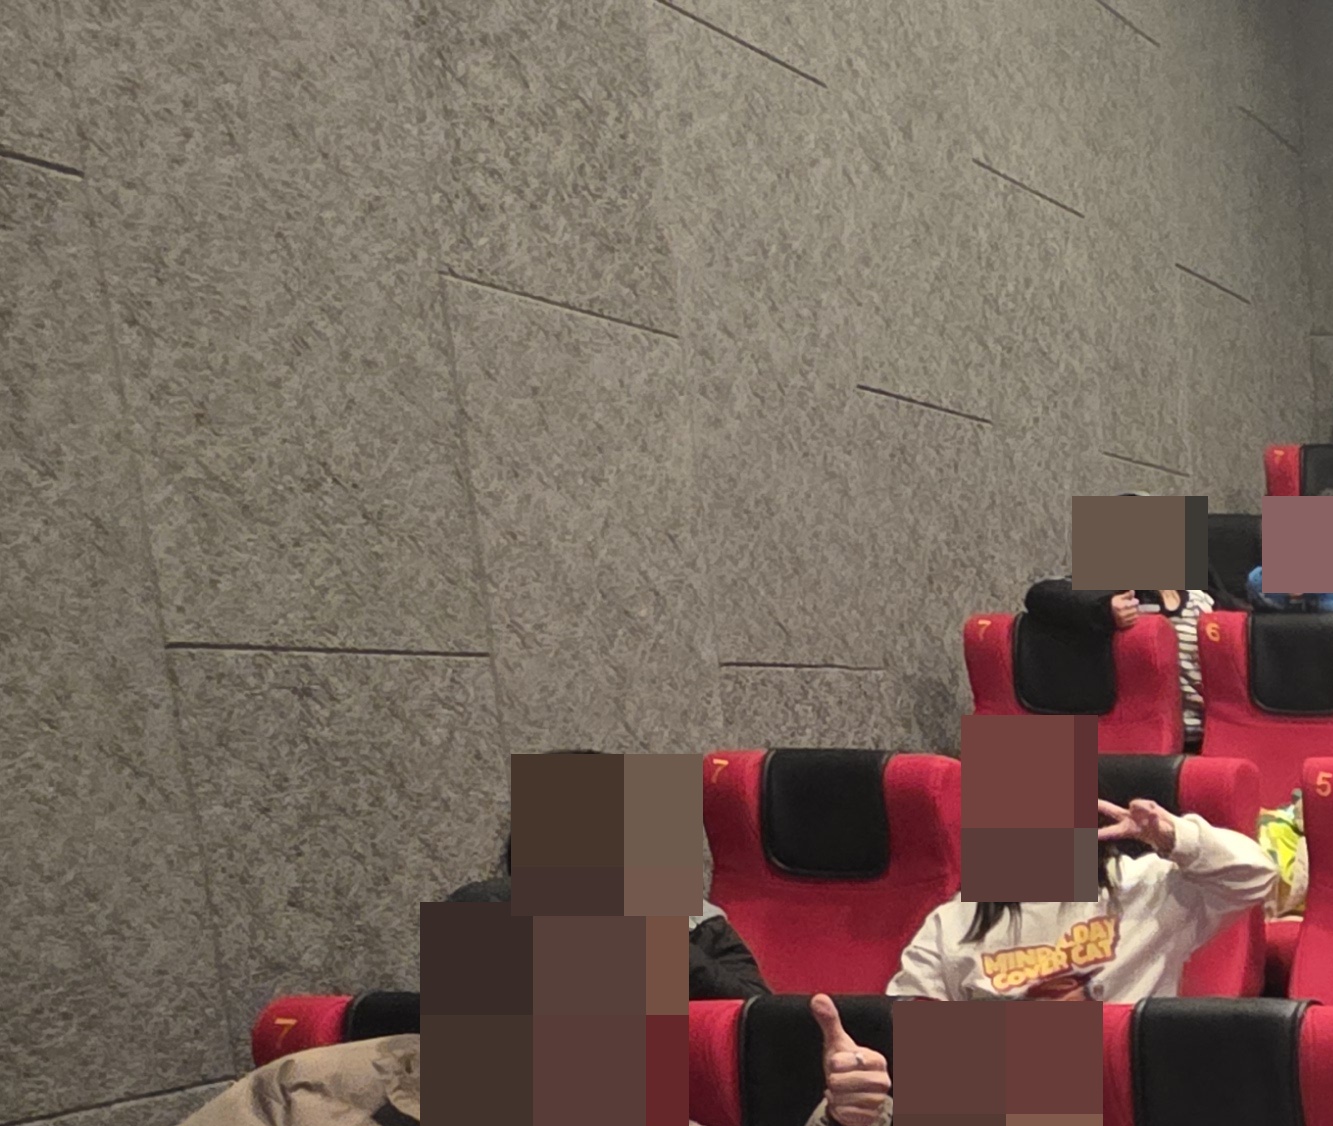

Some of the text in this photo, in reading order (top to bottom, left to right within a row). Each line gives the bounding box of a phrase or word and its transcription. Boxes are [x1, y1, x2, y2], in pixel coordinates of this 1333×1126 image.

[977, 619, 990, 641] 7
[1205, 622, 1221, 642] 6
[712, 758, 729, 784] 7
[1316, 771, 1333, 798] 5
[273, 1017, 297, 1047] 7
